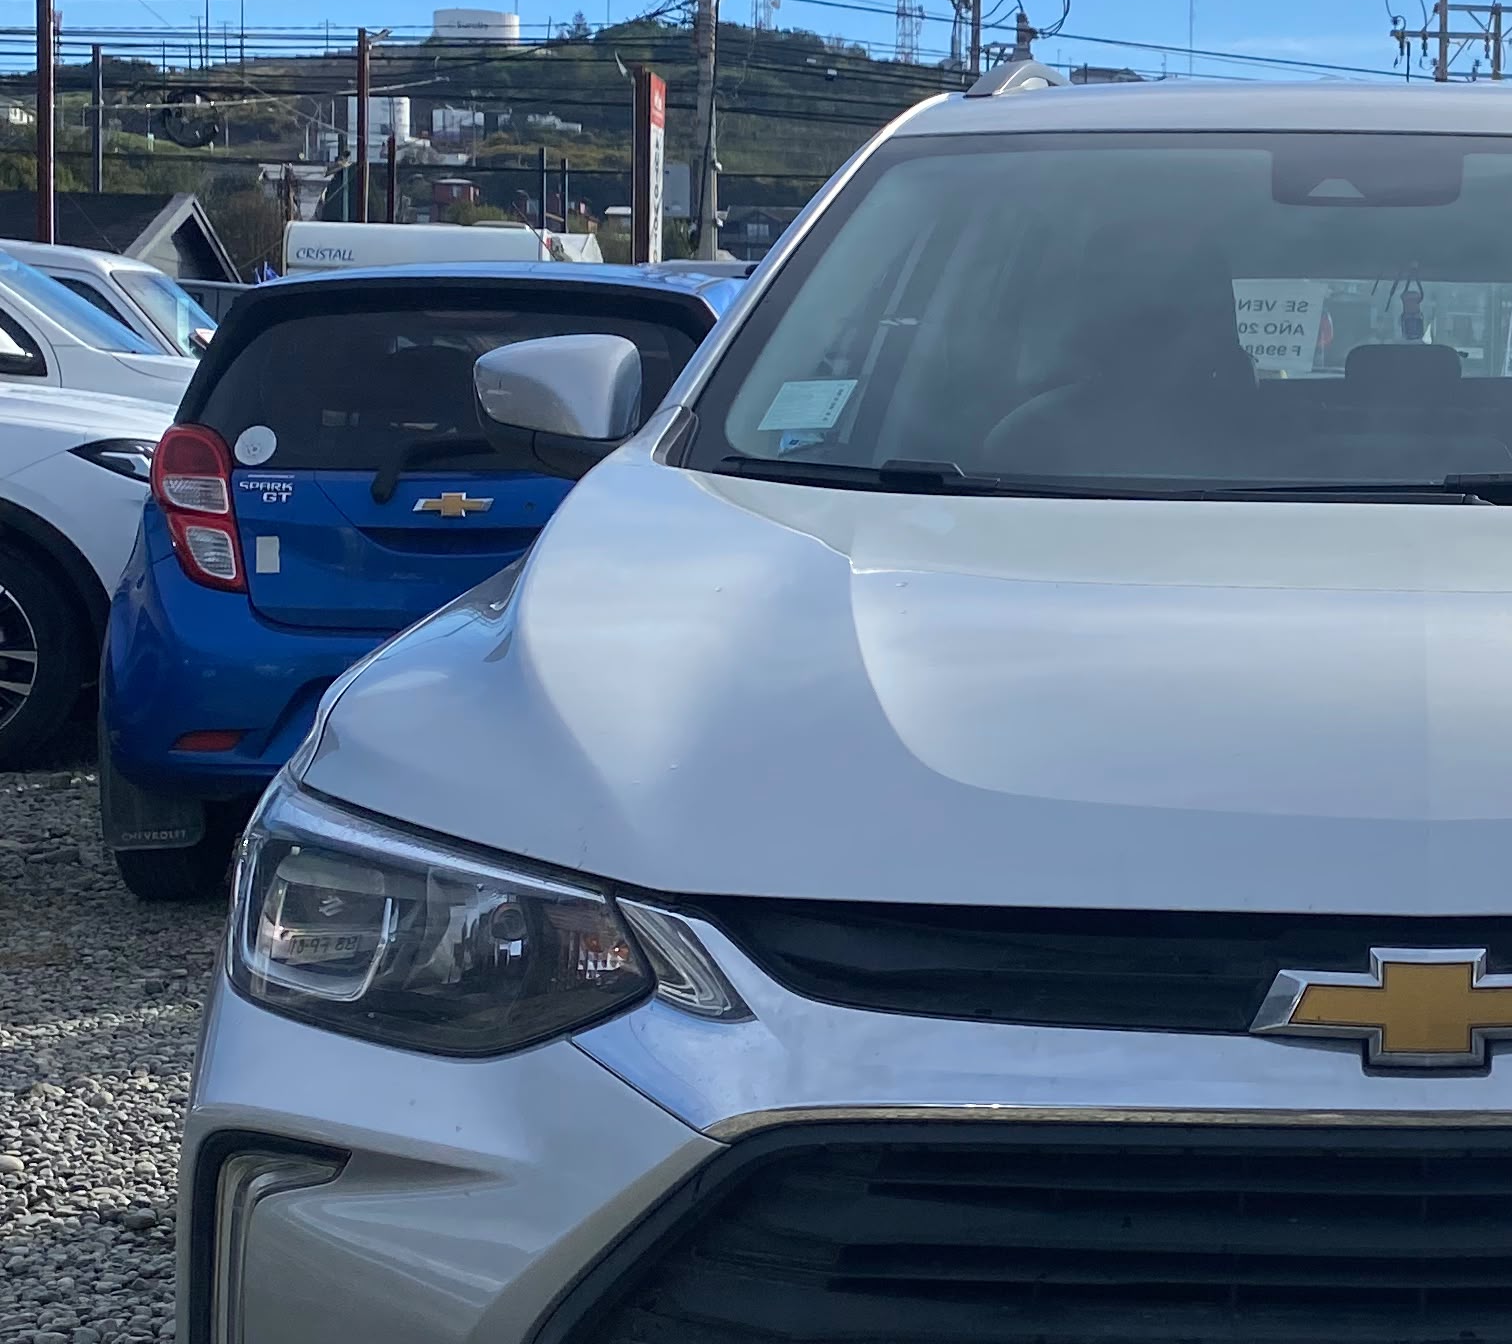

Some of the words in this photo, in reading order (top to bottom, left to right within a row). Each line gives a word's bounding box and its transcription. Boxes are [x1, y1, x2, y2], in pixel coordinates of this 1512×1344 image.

[296, 247, 355, 262] CRISTALL
[239, 481, 294, 492] SPARK
[262, 492, 292, 503] GT
